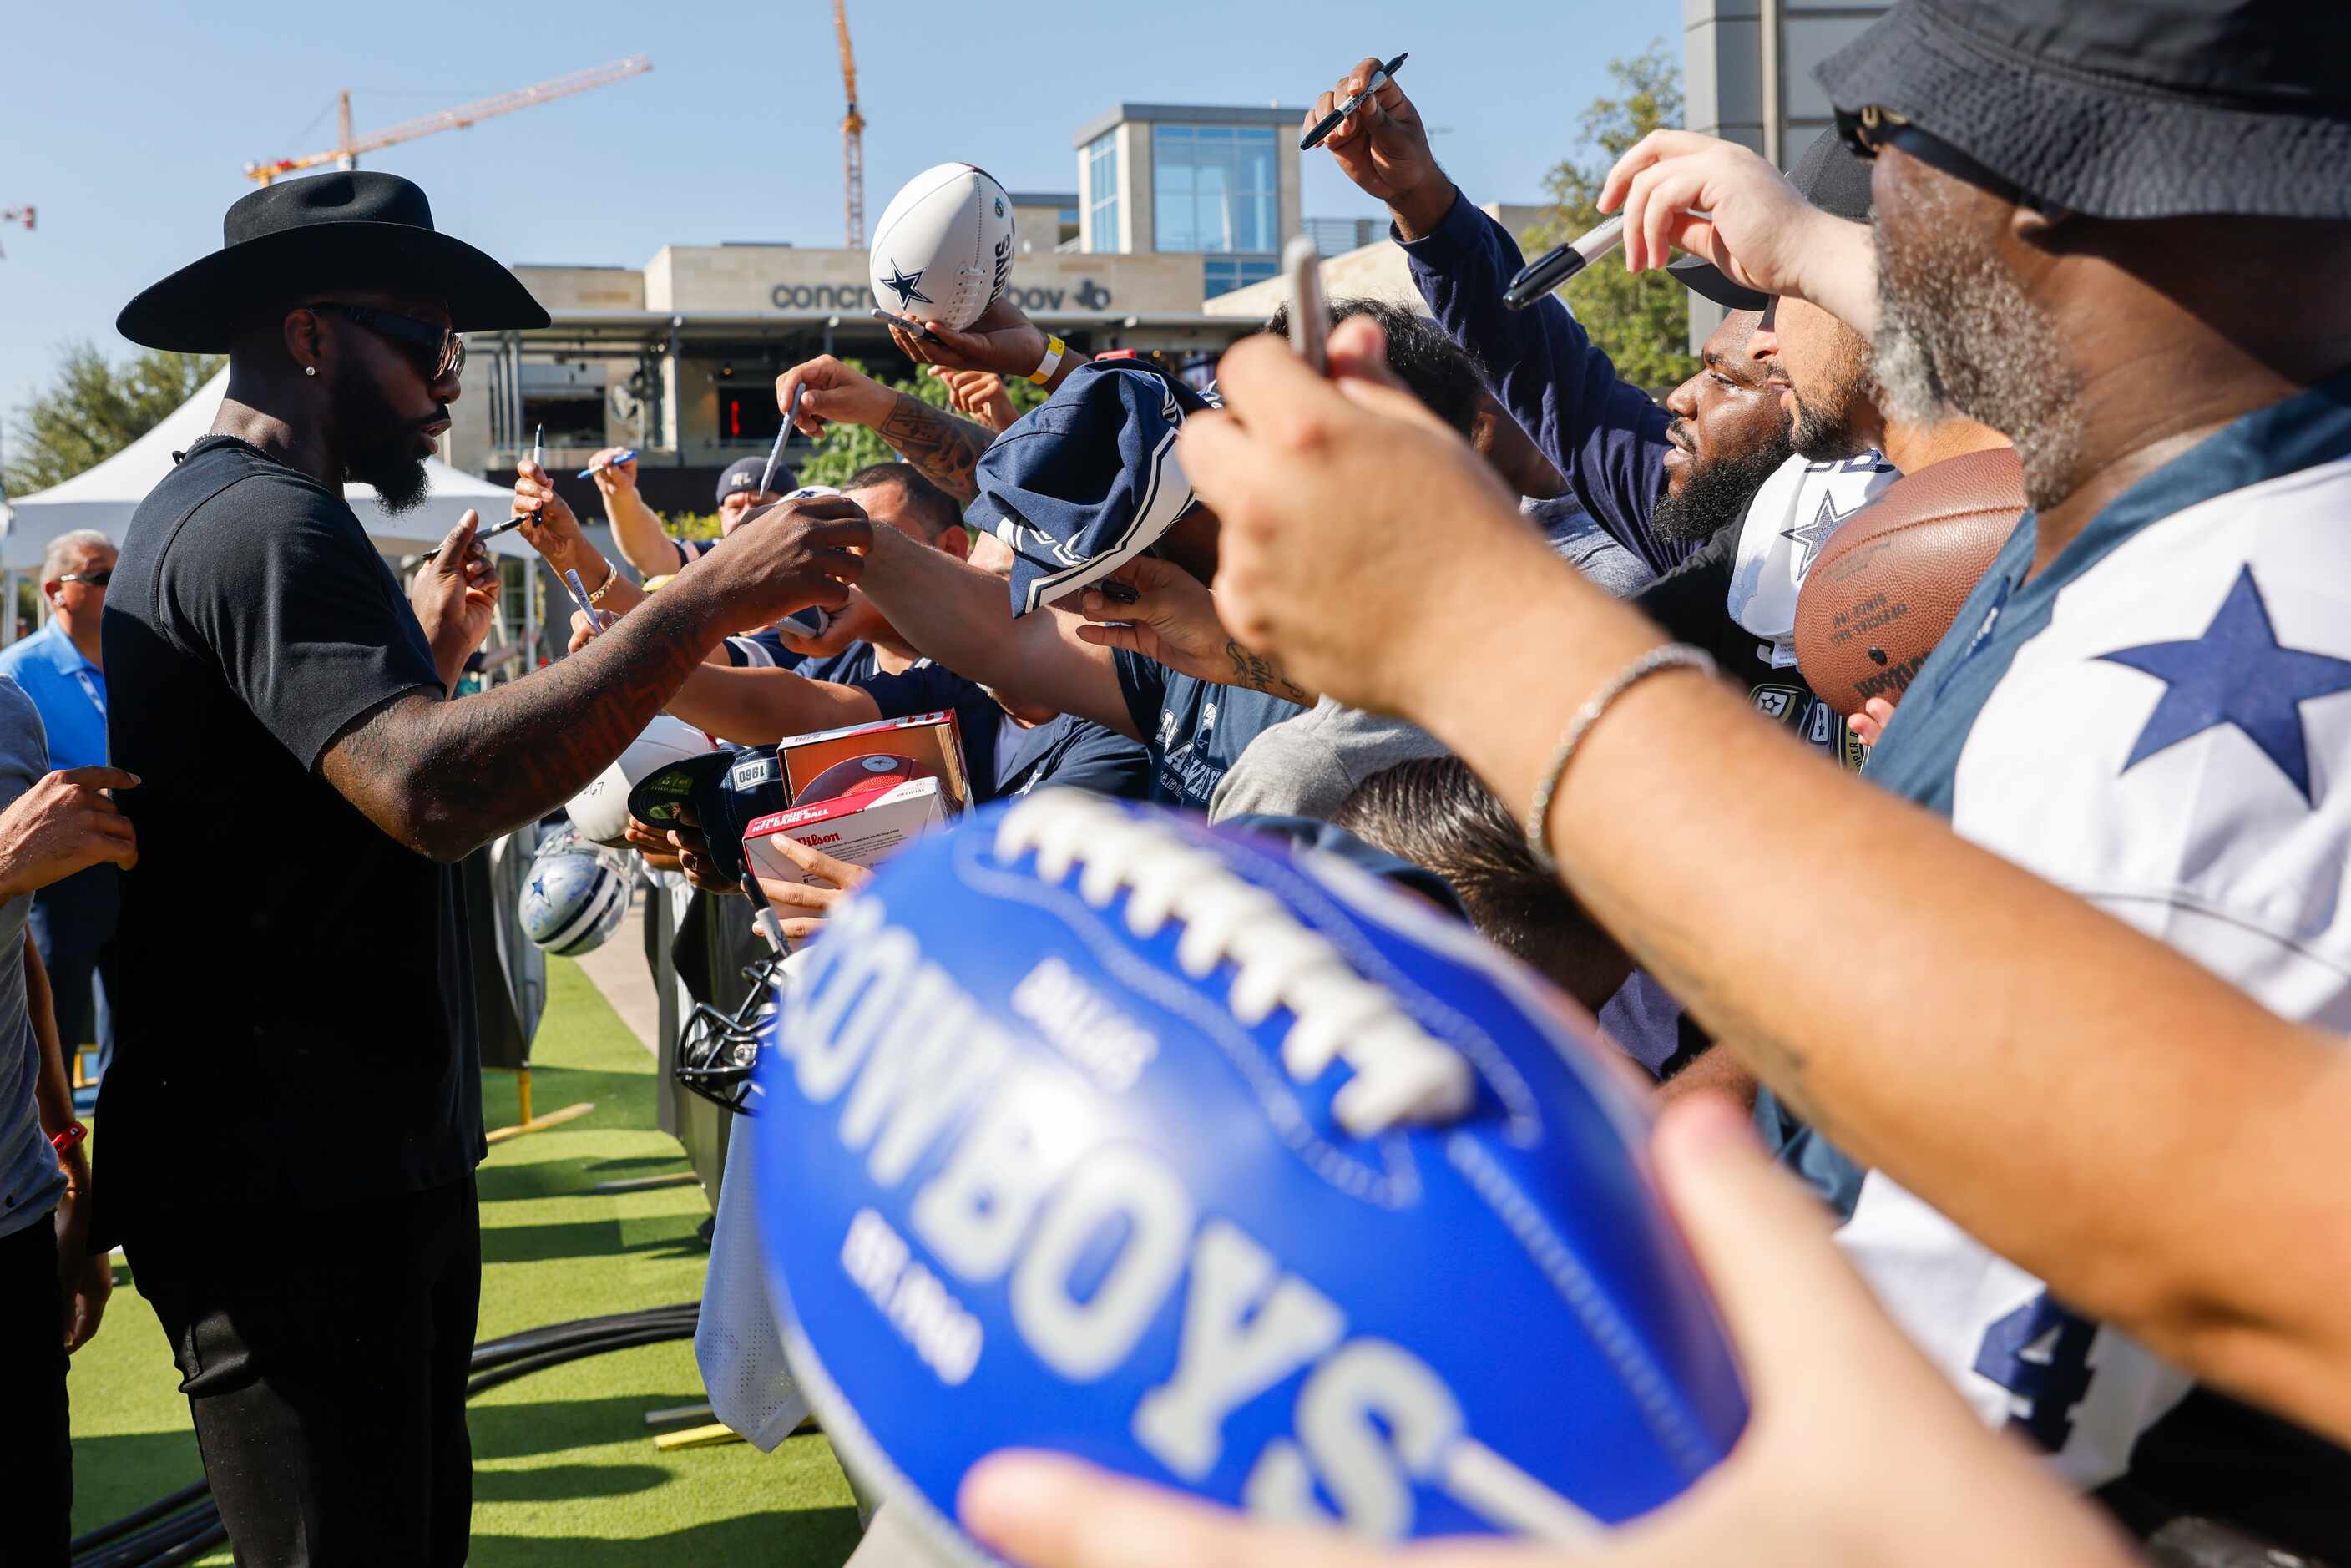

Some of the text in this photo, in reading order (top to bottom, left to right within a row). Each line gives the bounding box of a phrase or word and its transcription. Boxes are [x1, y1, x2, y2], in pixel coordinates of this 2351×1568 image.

[771, 283, 877, 309] concr
[1848, 742, 1863, 768] UPER
[736, 766, 764, 783] 1960
[804, 808, 829, 820] BALL
